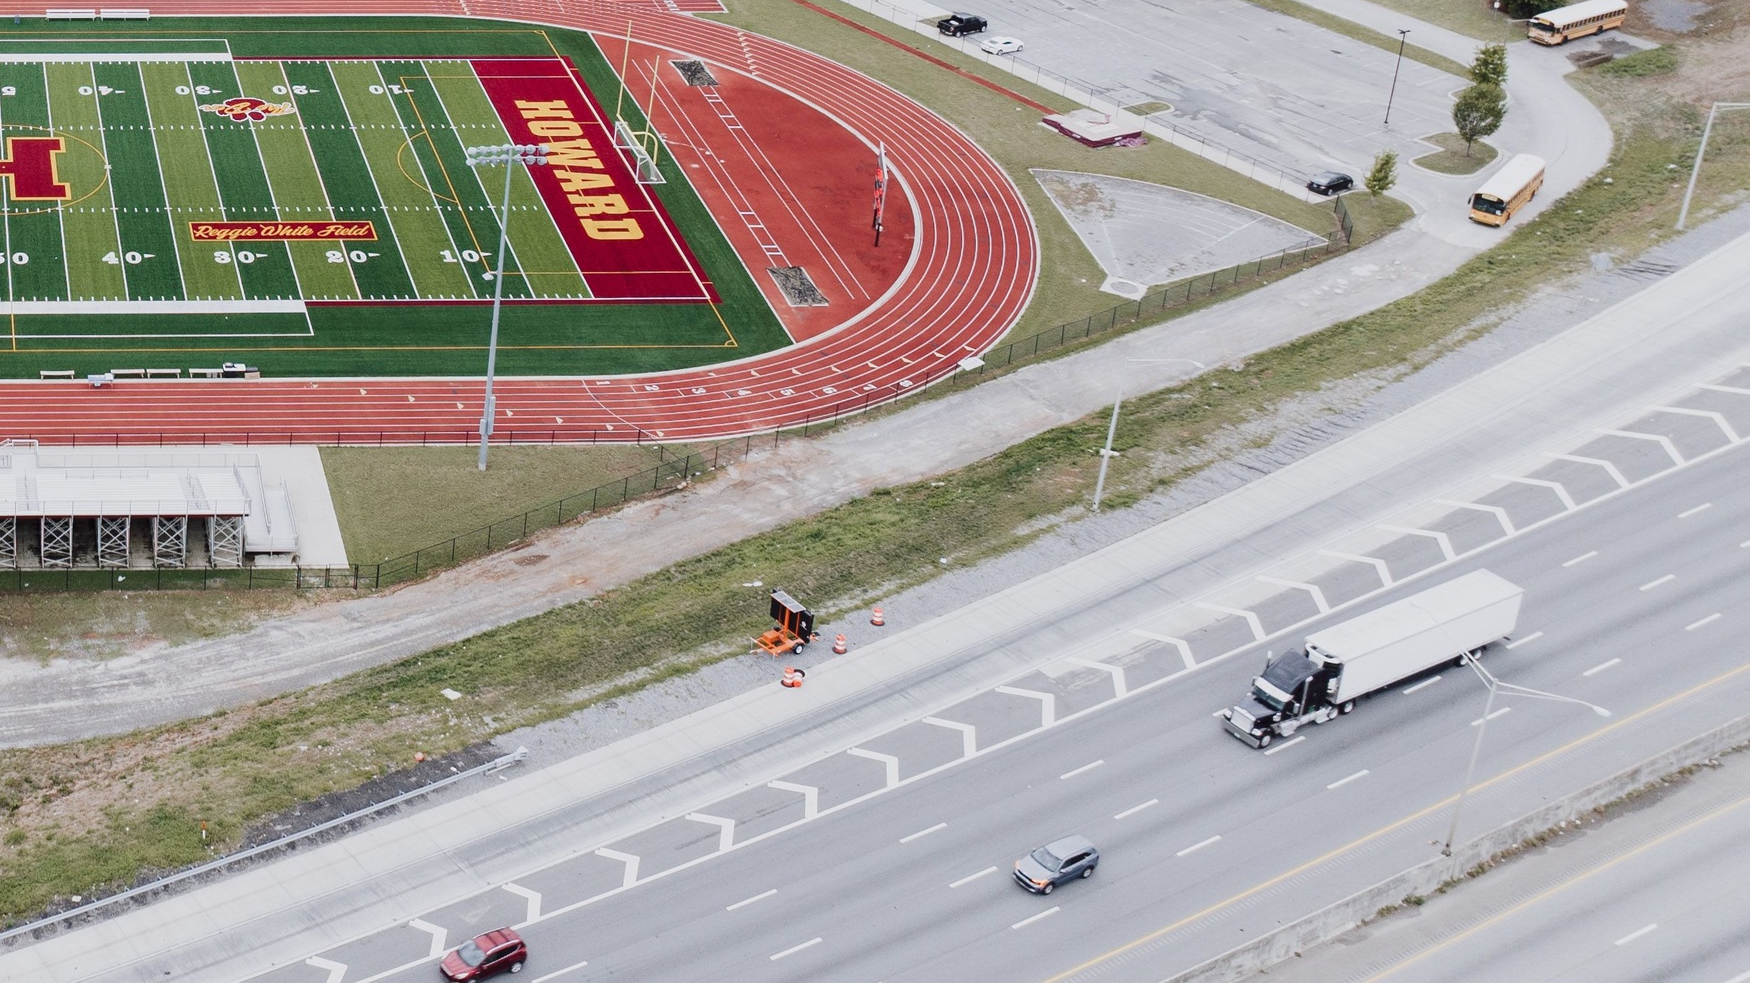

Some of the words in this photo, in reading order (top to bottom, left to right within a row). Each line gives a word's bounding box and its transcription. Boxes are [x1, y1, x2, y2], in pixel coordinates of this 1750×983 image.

[514, 100, 644, 240] HOWARD
[194, 224, 258, 239] Reggie
[259, 224, 314, 237] White
[317, 224, 369, 237] Field
